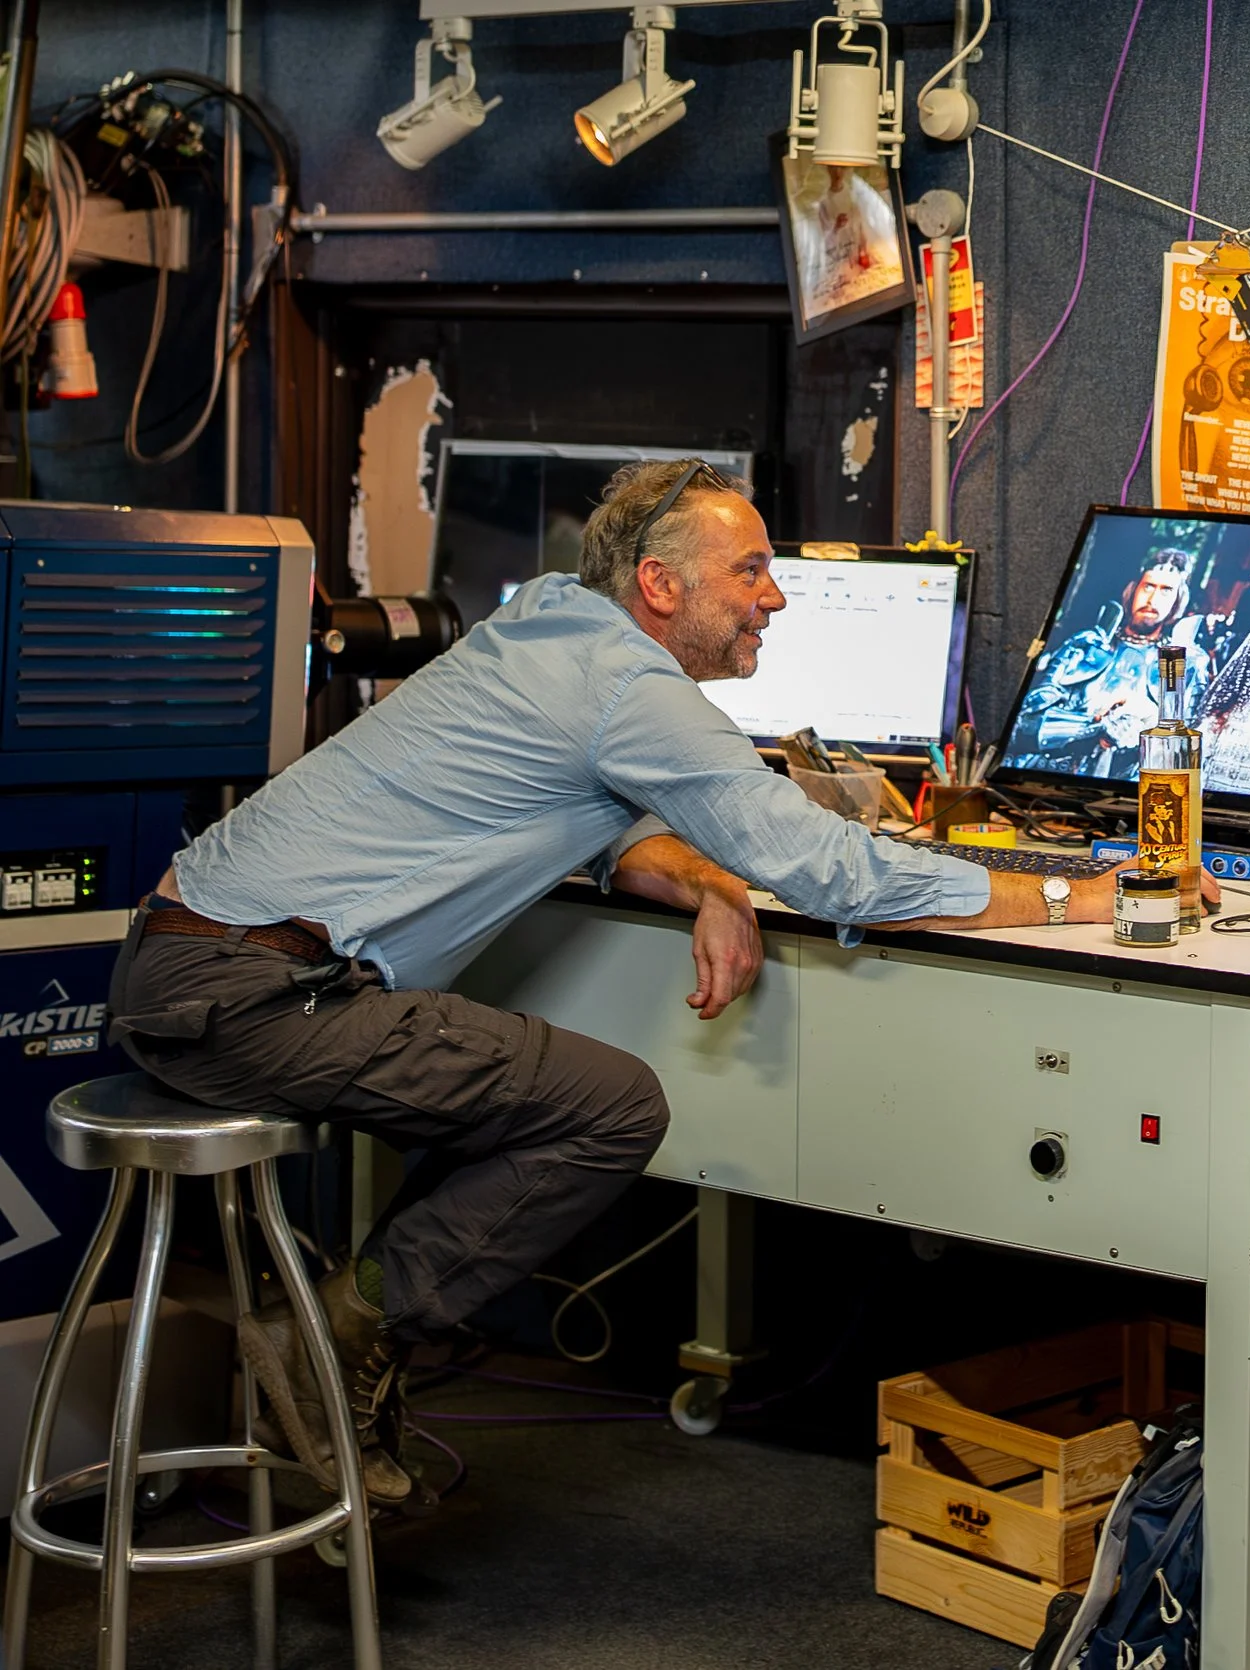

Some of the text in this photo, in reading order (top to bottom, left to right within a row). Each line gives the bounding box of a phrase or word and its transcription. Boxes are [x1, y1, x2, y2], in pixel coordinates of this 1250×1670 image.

[1179, 286, 1239, 317] Stra
[1181, 470, 1194, 480] THE
[1228, 478, 1242, 489] THE
[1217, 488, 1239, 500] WHEN
[1239, 491, 1245, 500] A
[1226, 500, 1241, 511] YOU
[0, 1003, 107, 1037] RISTIE
[24, 1041, 47, 1055] CP
[947, 1502, 991, 1527] WILD
